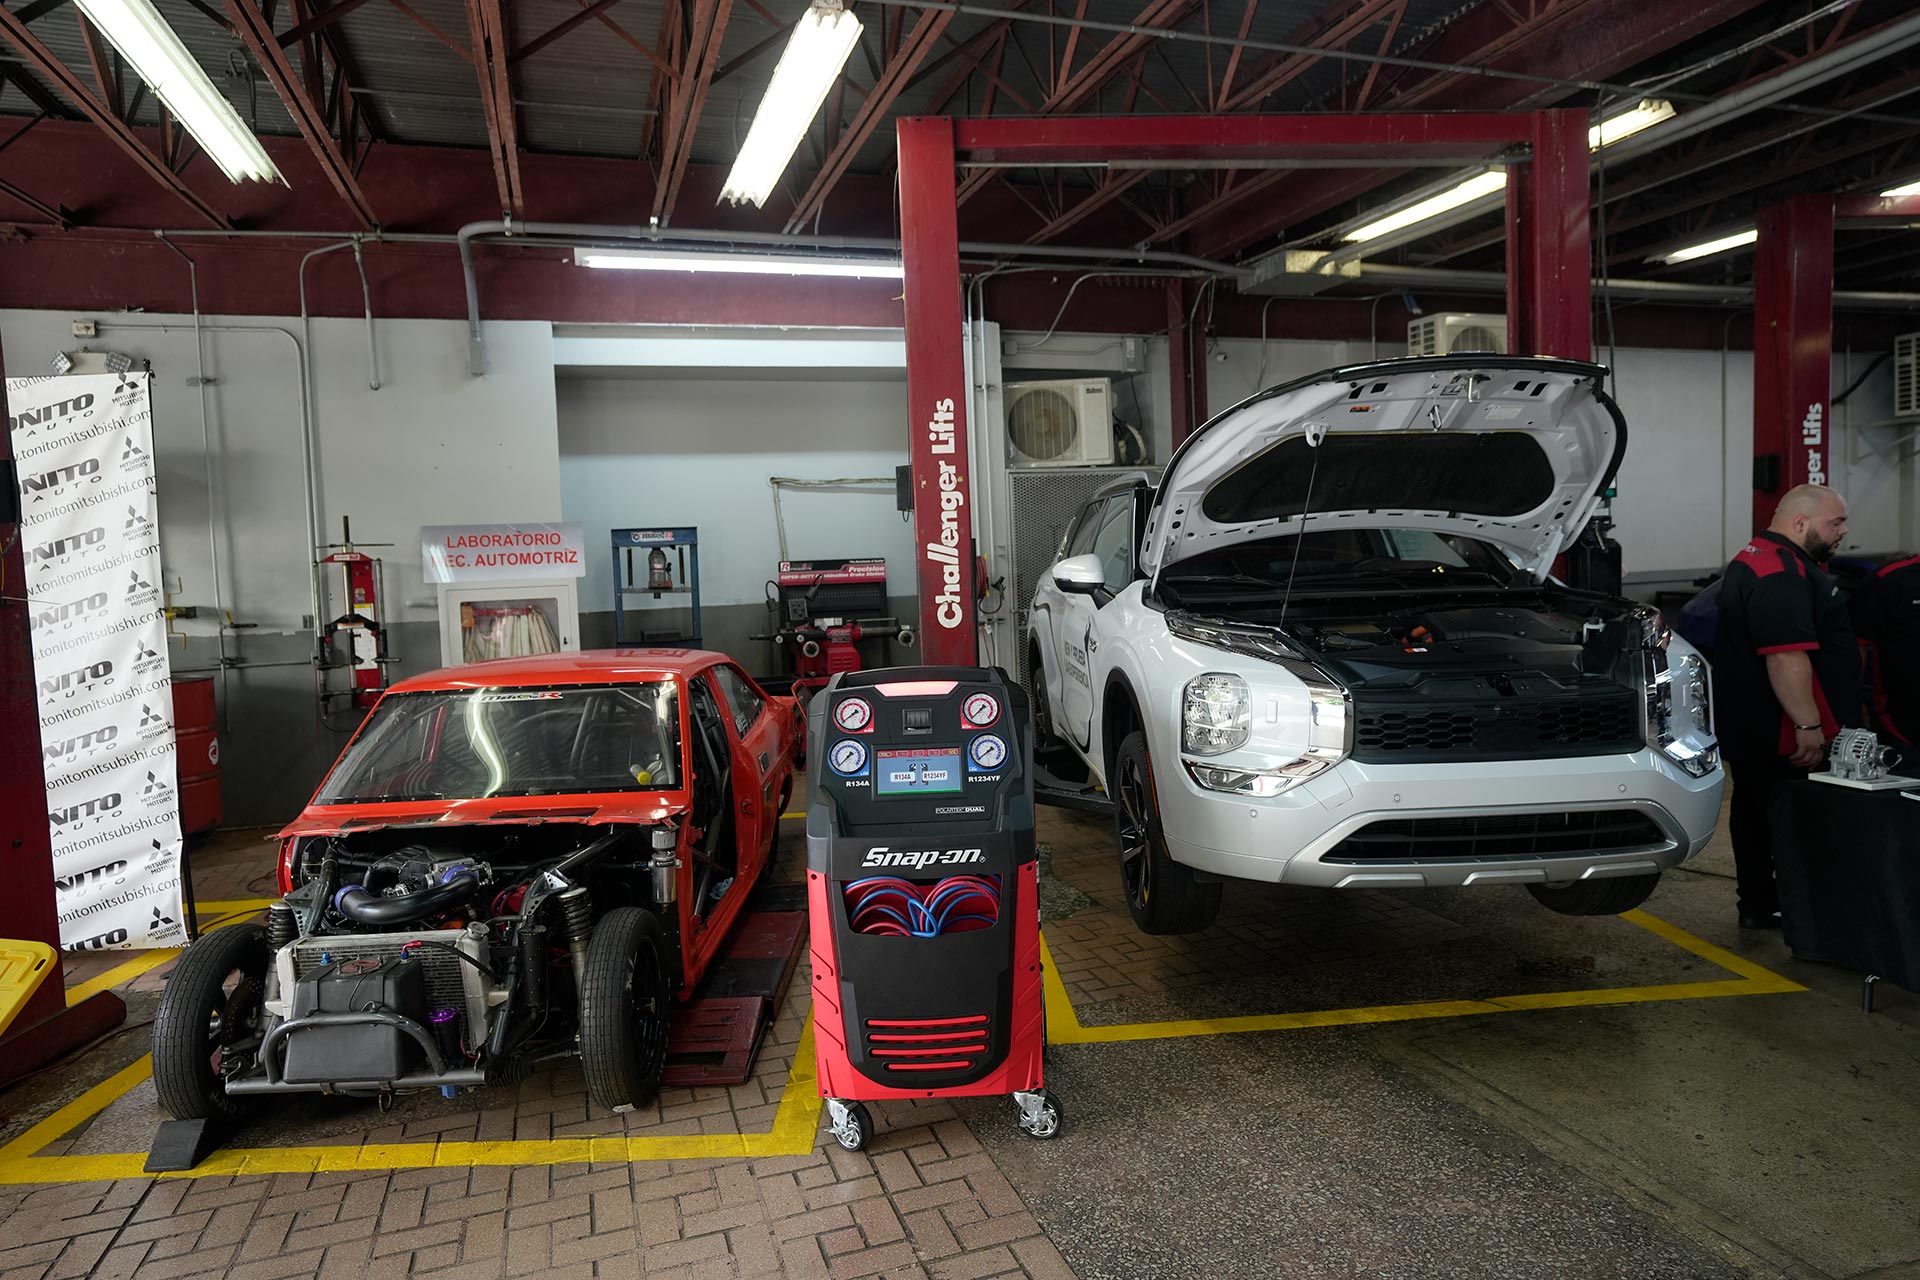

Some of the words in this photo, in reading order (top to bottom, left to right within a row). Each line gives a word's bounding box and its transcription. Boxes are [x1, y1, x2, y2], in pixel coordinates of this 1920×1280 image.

[26, 410, 93, 437] AUTO
[929, 398, 956, 454] Lifts
[1802, 402, 1823, 445] Lifts
[119, 454, 151, 469] MITSUBISHI
[124, 462, 148, 473] MOTORS
[20, 458, 99, 495] ÑITO
[32, 475, 102, 503] AUTO
[122, 522, 155, 537] MITSUBISHI
[127, 530, 152, 542] MOTORS
[446, 532, 561, 549] LABORATORIO
[927, 460, 964, 629] Challenger
[40, 544, 106, 571] AUTO
[431, 554, 471, 569] EC.
[124, 588, 159, 603] MITSUBISHI
[130, 595, 157, 607] MOTORS
[44, 609, 109, 637] AUTO
[33, 607, 165, 660] .tonitomitsubishi.com
[130, 656, 165, 671] MITSUBISHI
[45, 678, 114, 705] AUTO
[141, 728, 168, 741] MOTORS
[46, 742, 117, 770] AUTO
[46, 741, 176, 791] onitomitsubishi.com
[923, 770, 947, 780] R1234YF
[968, 775, 1001, 783] R1234YF
[141, 788, 175, 803] MITSUBISHI
[146, 796, 172, 808] MOTORS
[965, 805, 985, 813] DUAL
[52, 810, 122, 838] AUTO
[147, 923, 182, 938] MITSUBISHI
[154, 930, 180, 941] MOTORS
